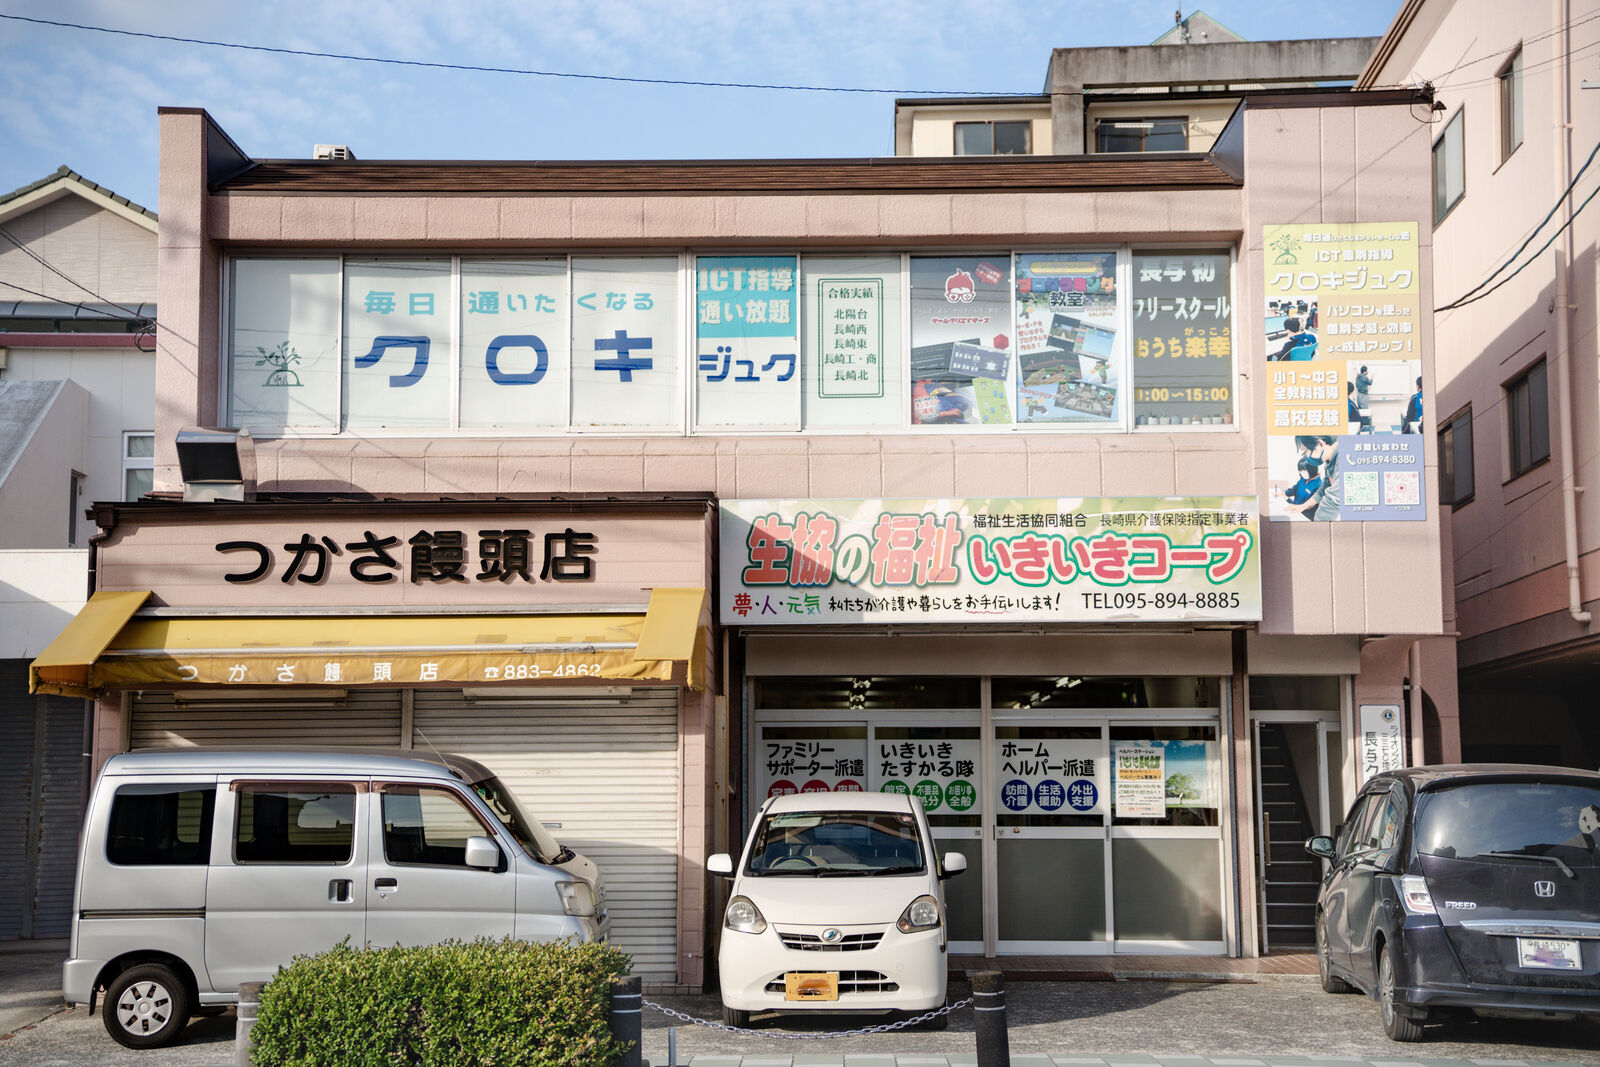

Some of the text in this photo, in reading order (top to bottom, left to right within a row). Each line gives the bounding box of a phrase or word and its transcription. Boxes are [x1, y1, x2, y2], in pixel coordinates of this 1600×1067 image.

[699, 267, 793, 292] ICT指導
[1270, 265, 1413, 291] クロキジュク
[827, 287, 874, 299] 合格実績
[1050, 291, 1084, 307] 教室
[699, 299, 791, 324] 通い放題
[833, 308, 868, 319] 北陽台
[834, 324, 867, 335] 長崎西
[1184, 327, 1231, 336] がっこう
[834, 338, 867, 350] 長崎東
[824, 353, 877, 365] 長崎工・商
[834, 370, 869, 381] 長崎北
[1273, 385, 1339, 401] 全教科指導
[1274, 409, 1340, 427] 高校受験
[1357, 455, 1416, 465] 095-894-8380
[973, 513, 1088, 528] 福祉生活協同組合
[1100, 512, 1250, 527] 長崎県介護保険指定事業者
[743, 512, 963, 586] 生協の福祉
[215, 527, 596, 584] つかさ饅頭店
[967, 528, 1253, 587] いきいきコープ
[766, 742, 835, 759] ファミリー
[880, 742, 953, 759] いきいき
[1002, 742, 1050, 758] ホーム
[766, 759, 865, 777] サポーター派遣
[880, 760, 975, 778] たすかる隊
[1002, 758, 1096, 777] ヘルパー派遣
[915, 784, 940, 795] 不要品
[948, 785, 972, 796] お困り事
[1005, 784, 1028, 795] 訪問
[1038, 784, 1061, 795] 生活
[1071, 784, 1093, 795] 外出
[949, 796, 972, 807] 全般
[1006, 796, 1028, 807] 介護
[1038, 796, 1061, 807] 援助
[1071, 796, 1094, 807] 支援
[1445, 901, 1477, 910] FREED
